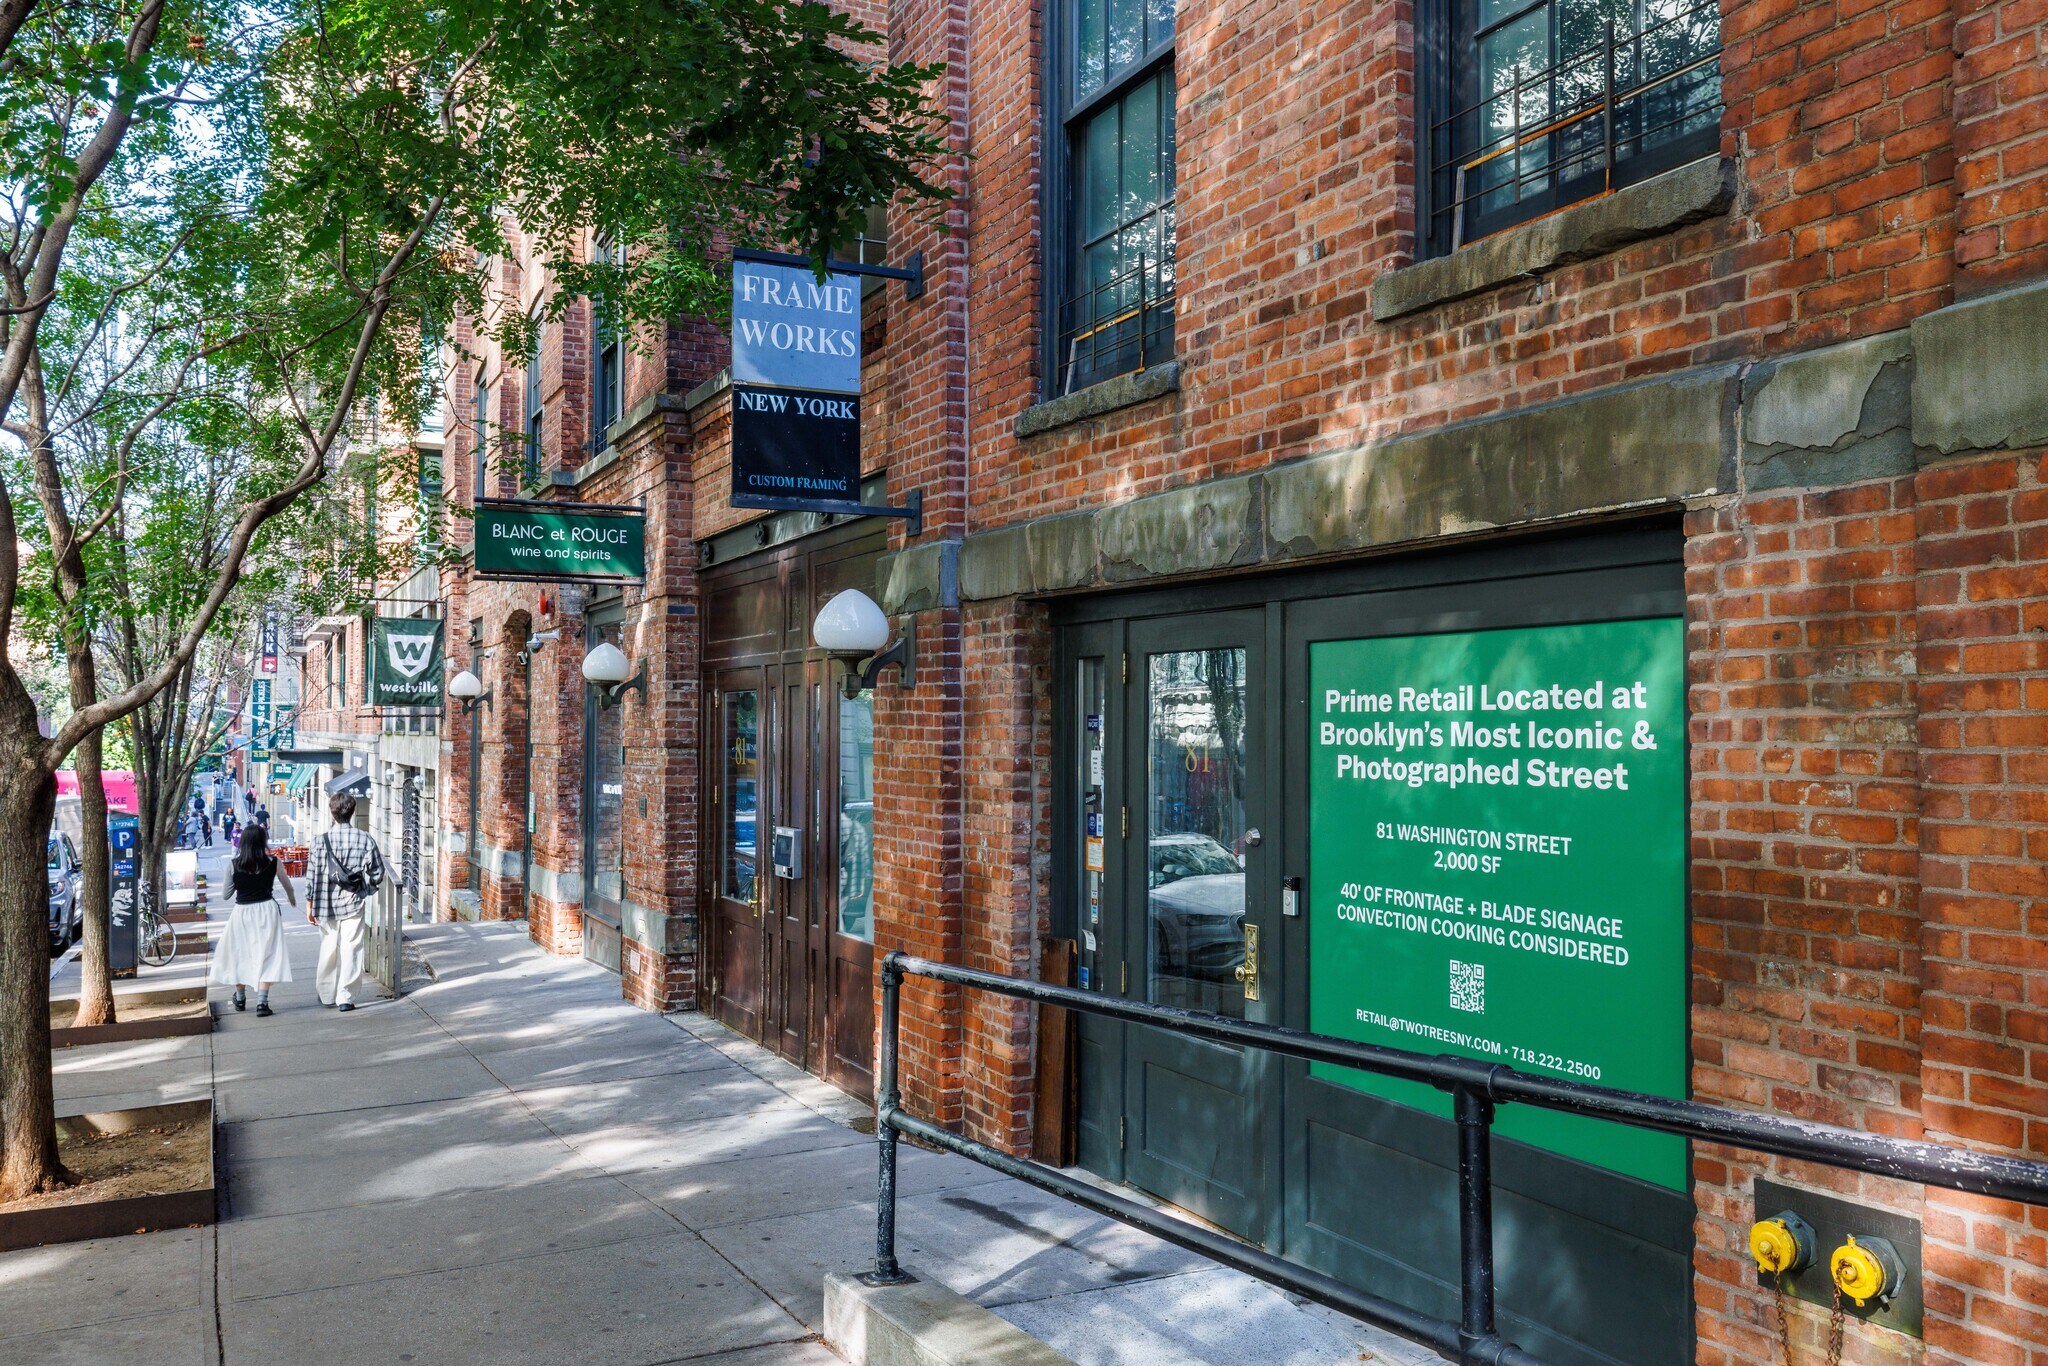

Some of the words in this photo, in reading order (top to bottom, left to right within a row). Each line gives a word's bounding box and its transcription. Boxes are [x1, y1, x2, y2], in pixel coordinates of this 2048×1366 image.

[742, 274, 854, 314] FRAME
[738, 318, 856, 357] WORKS
[738, 391, 790, 415] NEW
[794, 396, 856, 420] YORK
[748, 474, 795, 488] CUSTOM
[797, 477, 847, 491] FRAMING
[492, 523, 544, 540] BLANC
[550, 528, 565, 541] et
[571, 527, 628, 544] ROUGE
[510, 546, 541, 557] wine
[544, 547, 571, 559] and
[573, 549, 611, 561] spirits
[393, 641, 427, 661] W
[379, 681, 439, 694] westville
[1325, 688, 1393, 713] Prime
[1398, 685, 1474, 713] Retail
[1480, 680, 1604, 711] Located
[1611, 680, 1648, 710] at
[735, 737, 747, 764] 81
[1319, 720, 1444, 753] Brooklyn’s
[1449, 720, 1521, 749] Most
[1528, 720, 1624, 751] Iconic
[1630, 718, 1658, 751] &
[1185, 735, 1211, 773] 81
[1337, 754, 1520, 789] Photographed
[1526, 758, 1629, 791] Street
[118, 831, 130, 847] P
[1376, 821, 1394, 842] 81
[1396, 823, 1501, 850] WASHINGTON
[1505, 832, 1572, 856] STREET
[1433, 850, 1479, 873] 2,000
[1481, 855, 1502, 874] SF
[1340, 882, 1361, 901] 40'
[1363, 885, 1383, 903] OF
[1385, 888, 1464, 915] FRONTAGE
[1467, 903, 1477, 916] +
[1481, 901, 1537, 926] BLADE
[1540, 909, 1624, 939] SIGNAGE
[1336, 903, 1428, 933] CONVECTION
[1431, 918, 1506, 946] COOKING
[1509, 930, 1630, 967] CONSIDERED
[1356, 1008, 1501, 1055] RETAIL@TWOTREESNY.COM
[1511, 1046, 1601, 1080] 718.222.2500
